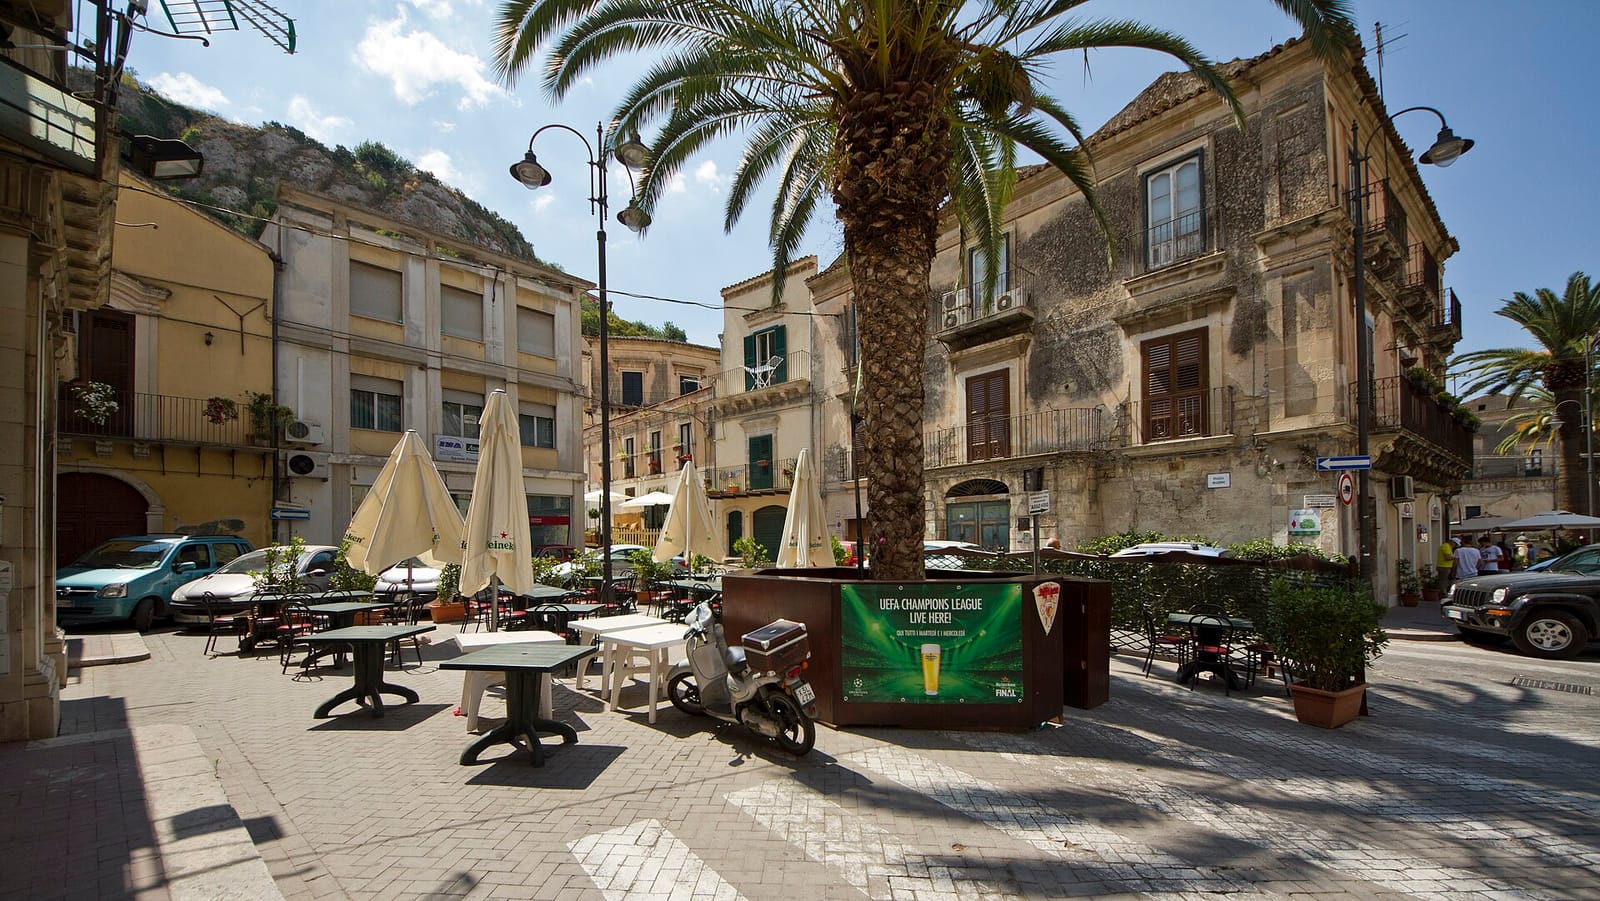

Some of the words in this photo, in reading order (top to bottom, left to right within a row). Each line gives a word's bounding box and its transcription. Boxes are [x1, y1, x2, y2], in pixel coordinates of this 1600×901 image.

[879, 598, 900, 610] UEFA
[901, 598, 950, 610] CHAMPIONS
[951, 598, 983, 610] LEAGUE
[909, 612, 927, 624] LIVE
[928, 612, 952, 624] HERE!
[995, 689, 1017, 697] FINAL
